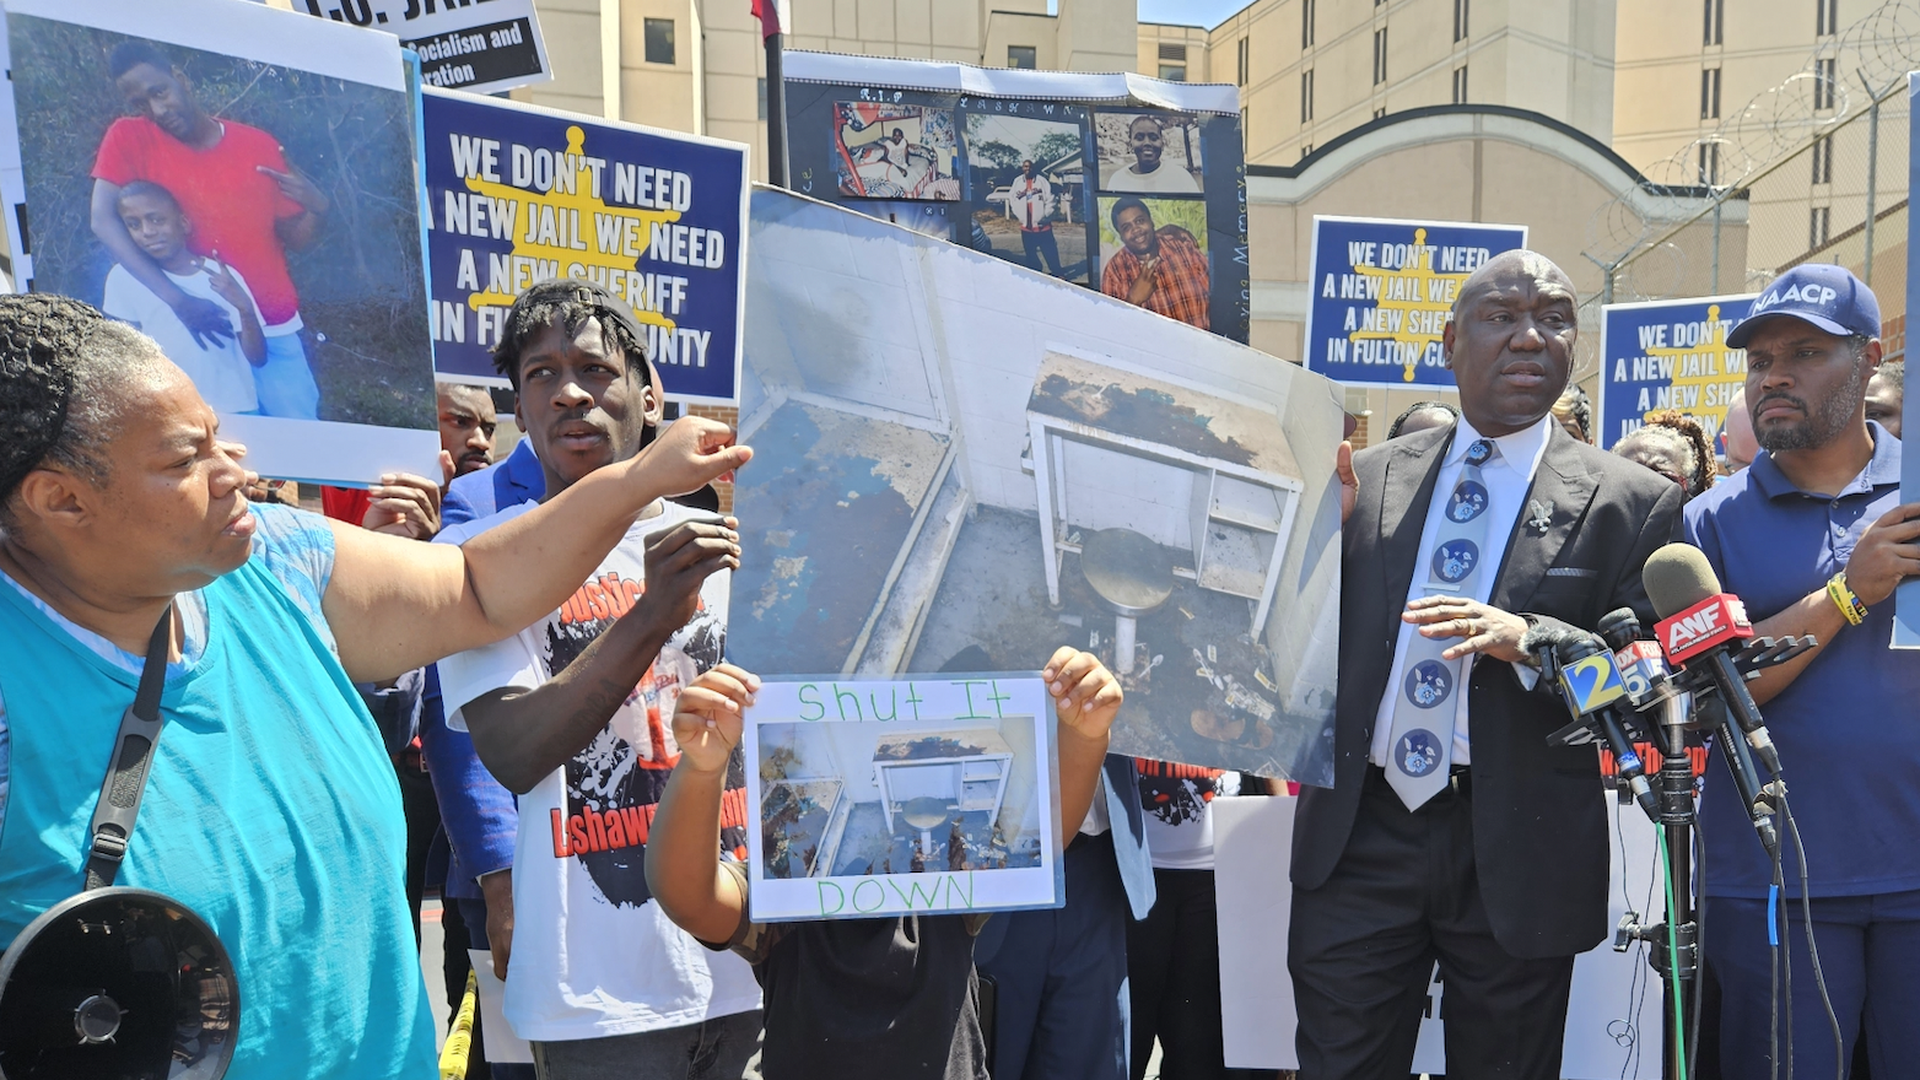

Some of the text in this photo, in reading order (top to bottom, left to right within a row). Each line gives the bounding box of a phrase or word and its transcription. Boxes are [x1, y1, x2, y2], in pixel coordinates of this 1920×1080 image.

[490, 22, 523, 48] and
[450, 133, 692, 213] WE DON'T NEED
[445, 190, 518, 242] NEW
[524, 202, 587, 250] JAIL
[594, 212, 640, 257] WE
[650, 221, 725, 269] NEED
[456, 249, 480, 291] A
[489, 254, 559, 296] NEW
[1348, 241, 1490, 272] WE DON'T NEED
[1322, 273, 1456, 303] A NEW JAIL WE
[1752, 283, 1837, 315] NAACP
[432, 299, 465, 343] IN
[1344, 306, 1357, 331] A
[1362, 307, 1404, 333] NEW
[1638, 320, 1732, 350] WE DON'T
[648, 325, 712, 368] UNTY
[1327, 337, 1347, 362] IN
[1353, 340, 1419, 365] FULTON
[1614, 358, 1628, 382] A
[1633, 355, 1676, 381] NEW
[1679, 352, 1718, 378] JAIL
[1637, 387, 1651, 411] A
[1656, 385, 1701, 410] NEW
[561, 572, 645, 624] ustic
[1669, 602, 1720, 649] ANF
[1615, 645, 1638, 668] OX
[1573, 655, 1625, 711] 2
[1622, 664, 1646, 695] 5
[799, 680, 1011, 723] Shut It
[551, 802, 659, 858] Lshaw
[817, 871, 974, 916] DOWN
